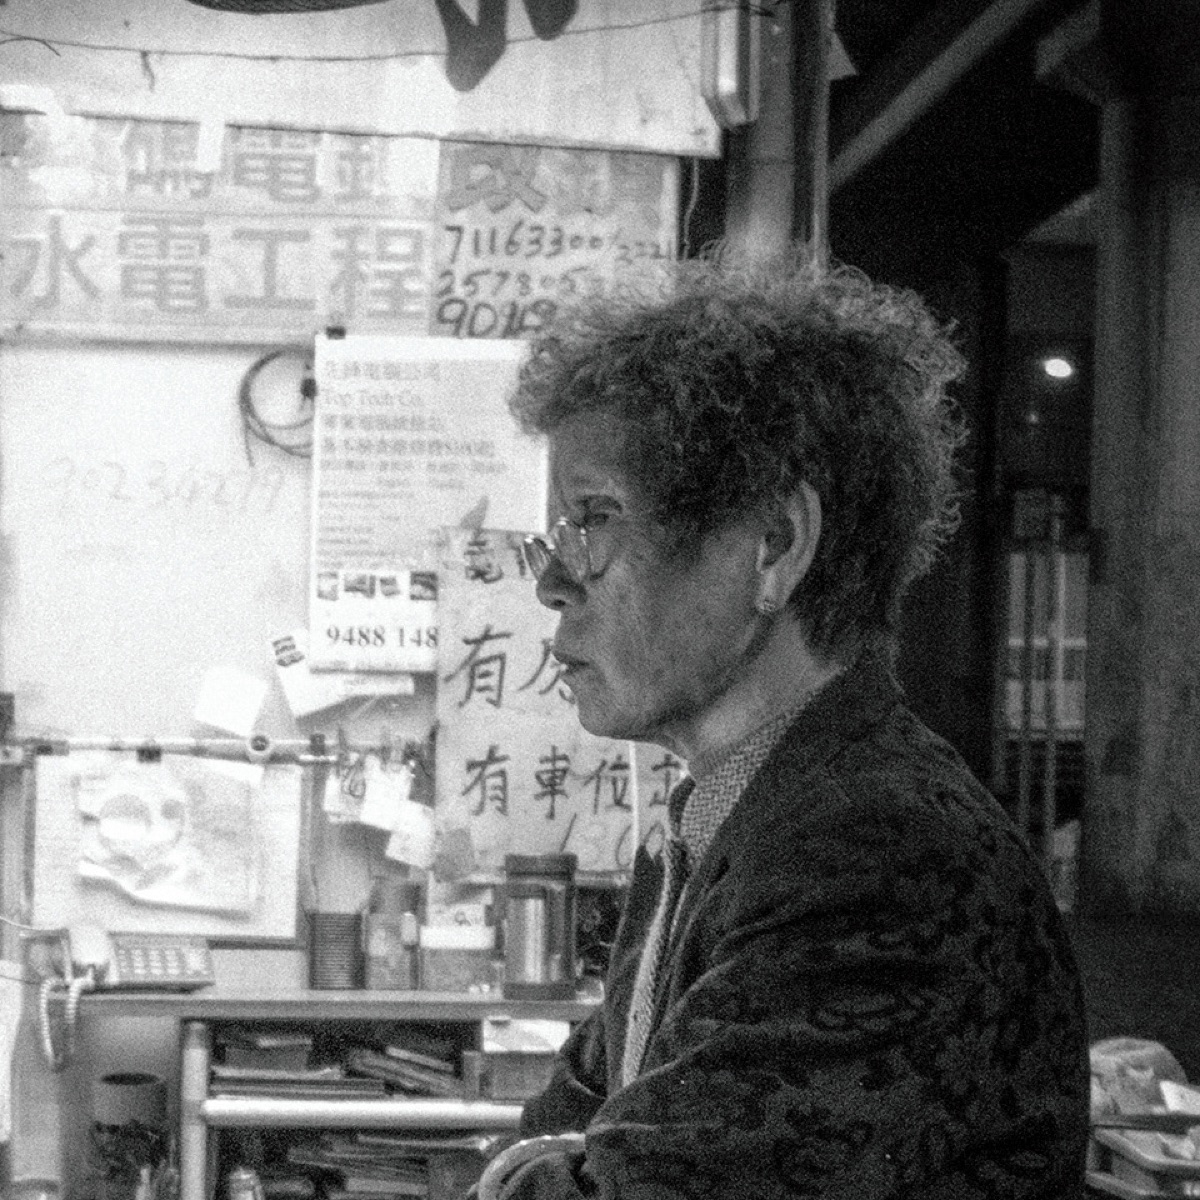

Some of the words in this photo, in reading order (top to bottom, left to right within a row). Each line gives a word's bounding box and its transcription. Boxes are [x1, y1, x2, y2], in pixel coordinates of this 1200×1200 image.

[8, 210, 426, 321] 水電工程
[326, 624, 386, 648] 9488
